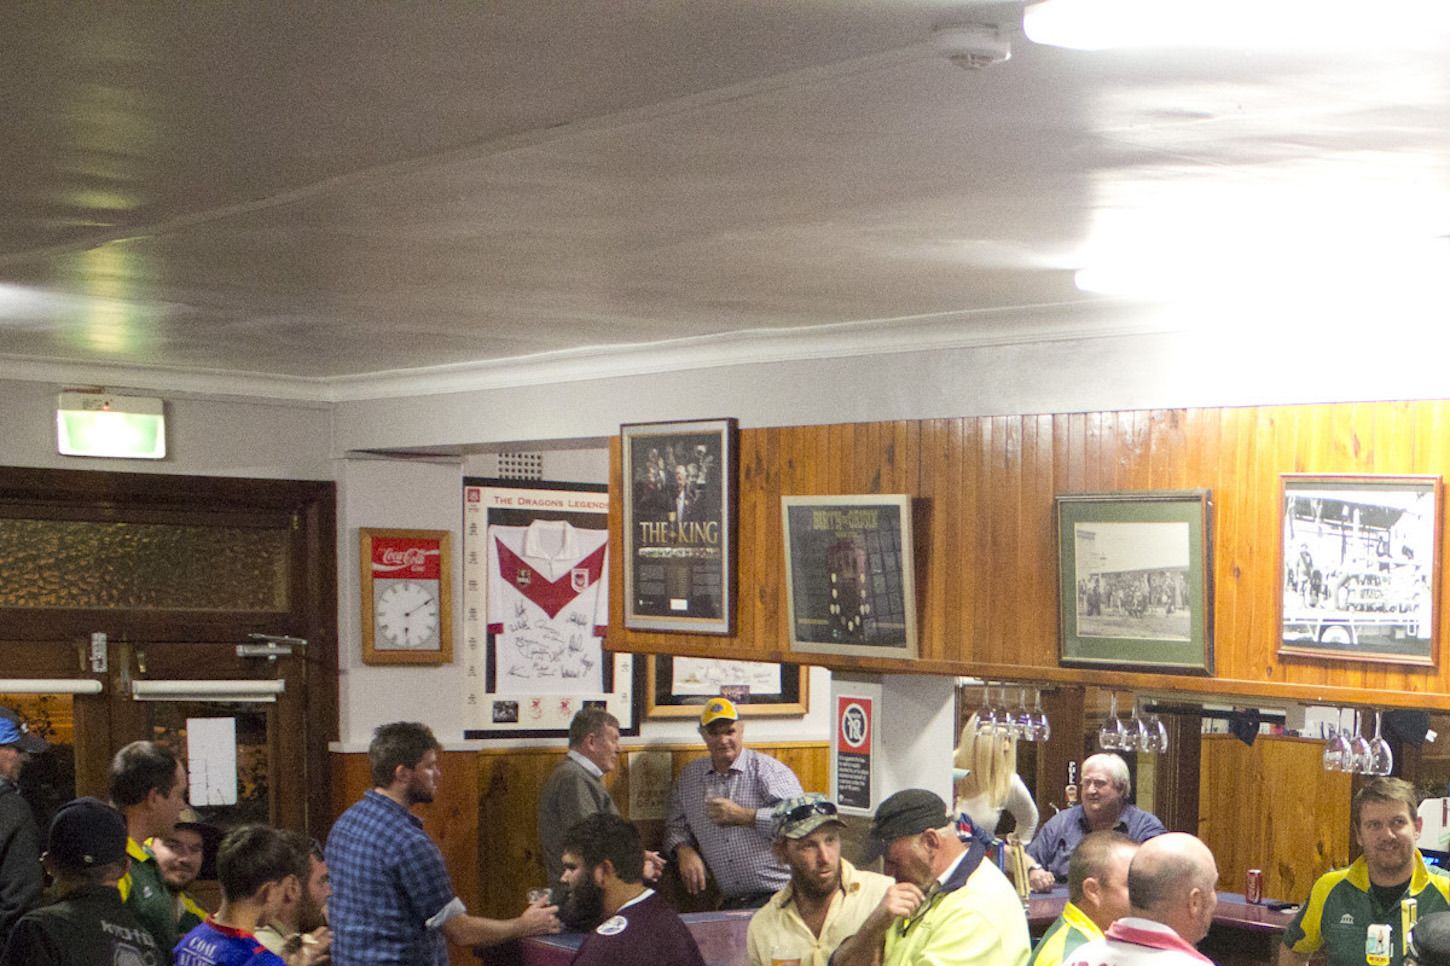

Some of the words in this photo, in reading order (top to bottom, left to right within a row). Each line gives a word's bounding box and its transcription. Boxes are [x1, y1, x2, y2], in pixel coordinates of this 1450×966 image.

[494, 496, 512, 505] THE
[518, 497, 564, 507] DRAGONS
[640, 521, 667, 544] THE
[678, 521, 718, 544] KING
